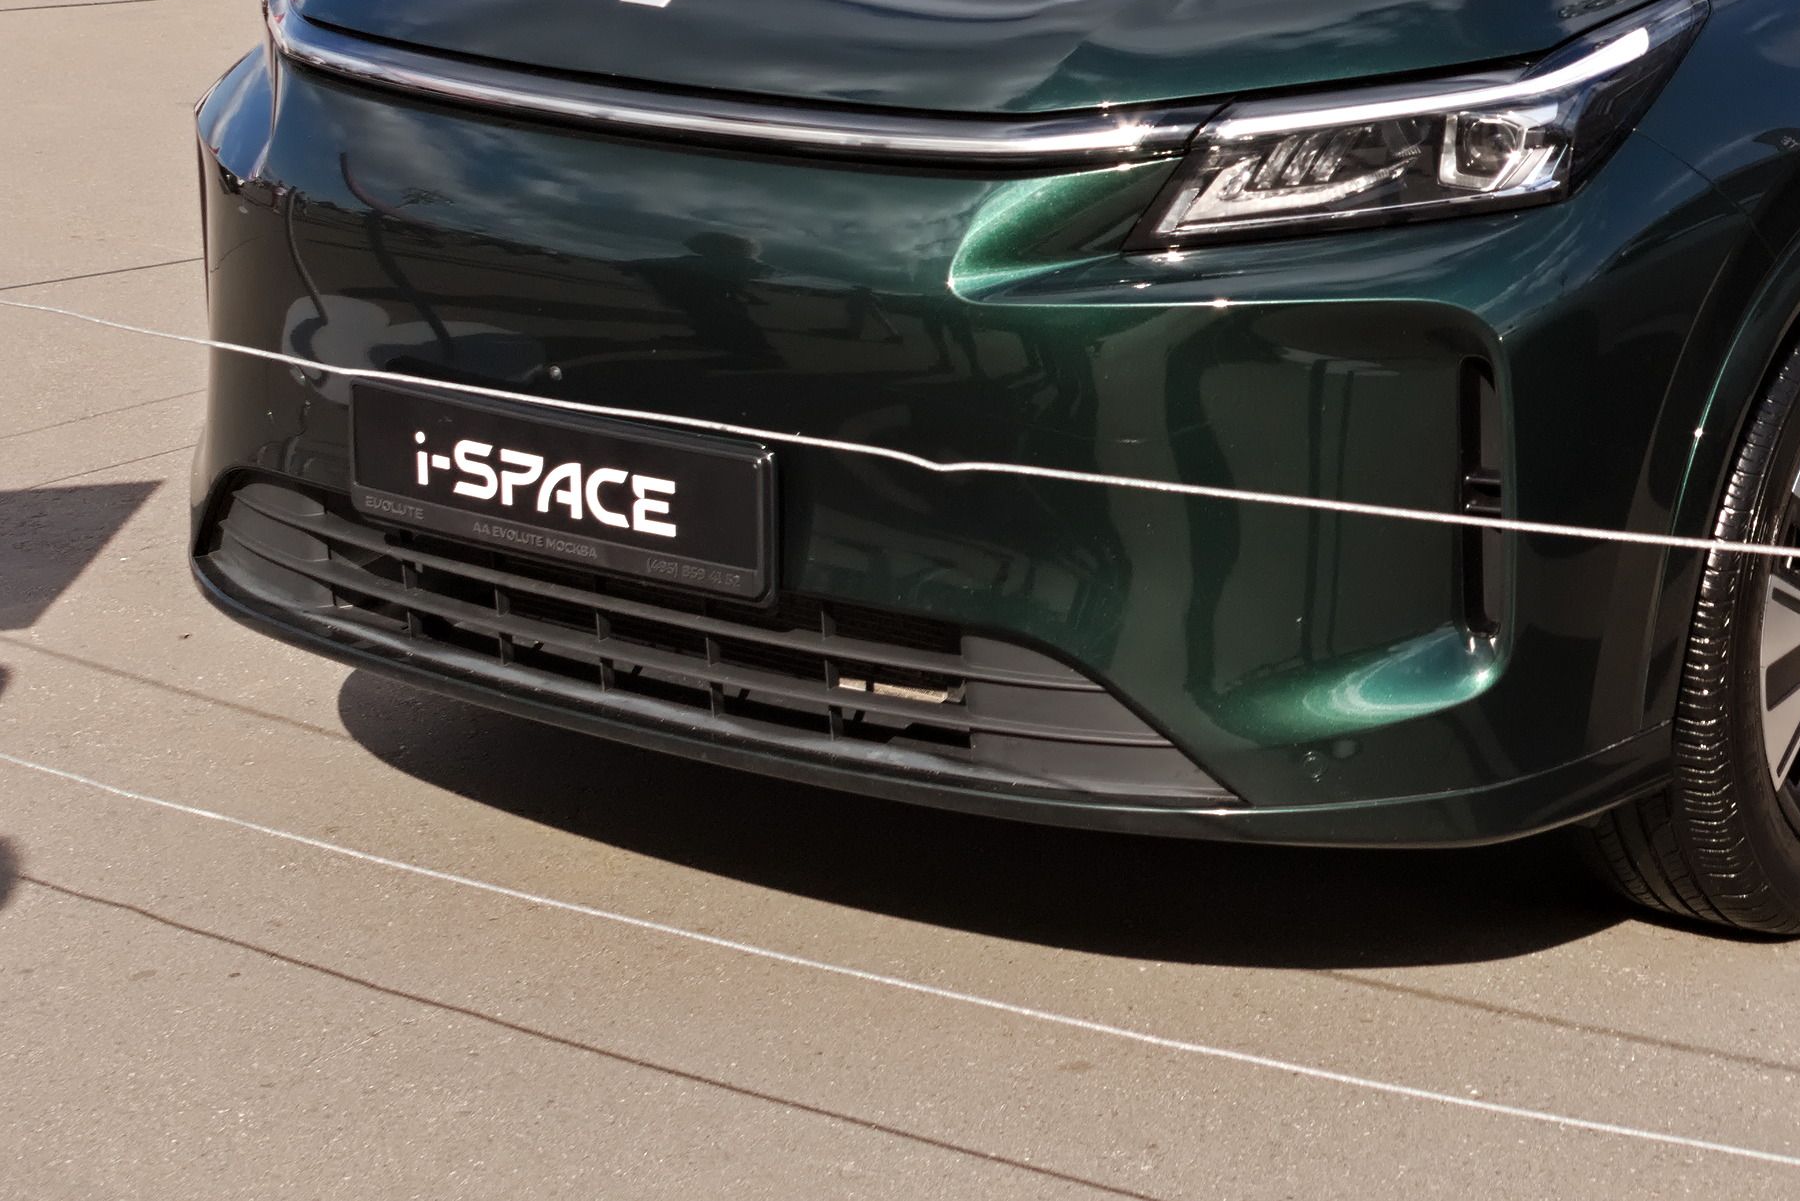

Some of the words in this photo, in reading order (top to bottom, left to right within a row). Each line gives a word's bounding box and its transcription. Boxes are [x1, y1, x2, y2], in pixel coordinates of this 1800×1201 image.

[414, 430, 677, 538] i-SPACE
[365, 496, 424, 520] EVOLUTE
[492, 526, 544, 548] EVOLUTE
[546, 538, 597, 560] МОСКВА
